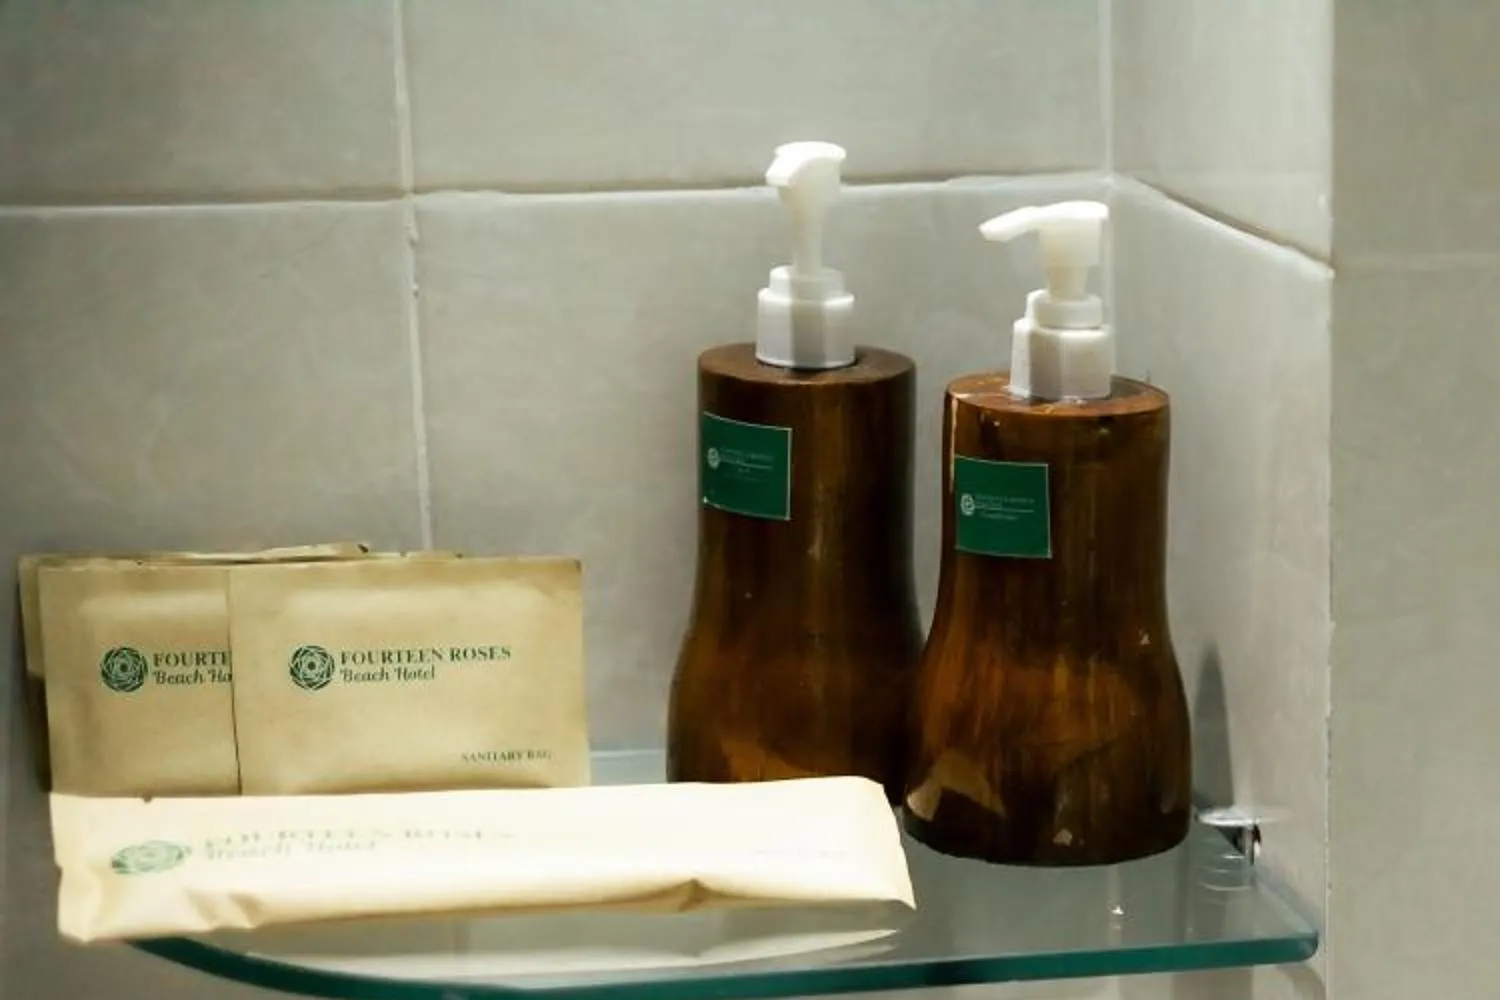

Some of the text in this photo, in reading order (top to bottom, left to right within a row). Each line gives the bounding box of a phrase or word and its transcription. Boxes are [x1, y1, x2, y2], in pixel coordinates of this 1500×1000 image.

[340, 646, 511, 665] FOURTEEN ROSES
[152, 668, 203, 685] Beach
[340, 665, 434, 682] Beach Hotel
[461, 751, 523, 762] SANITARY
